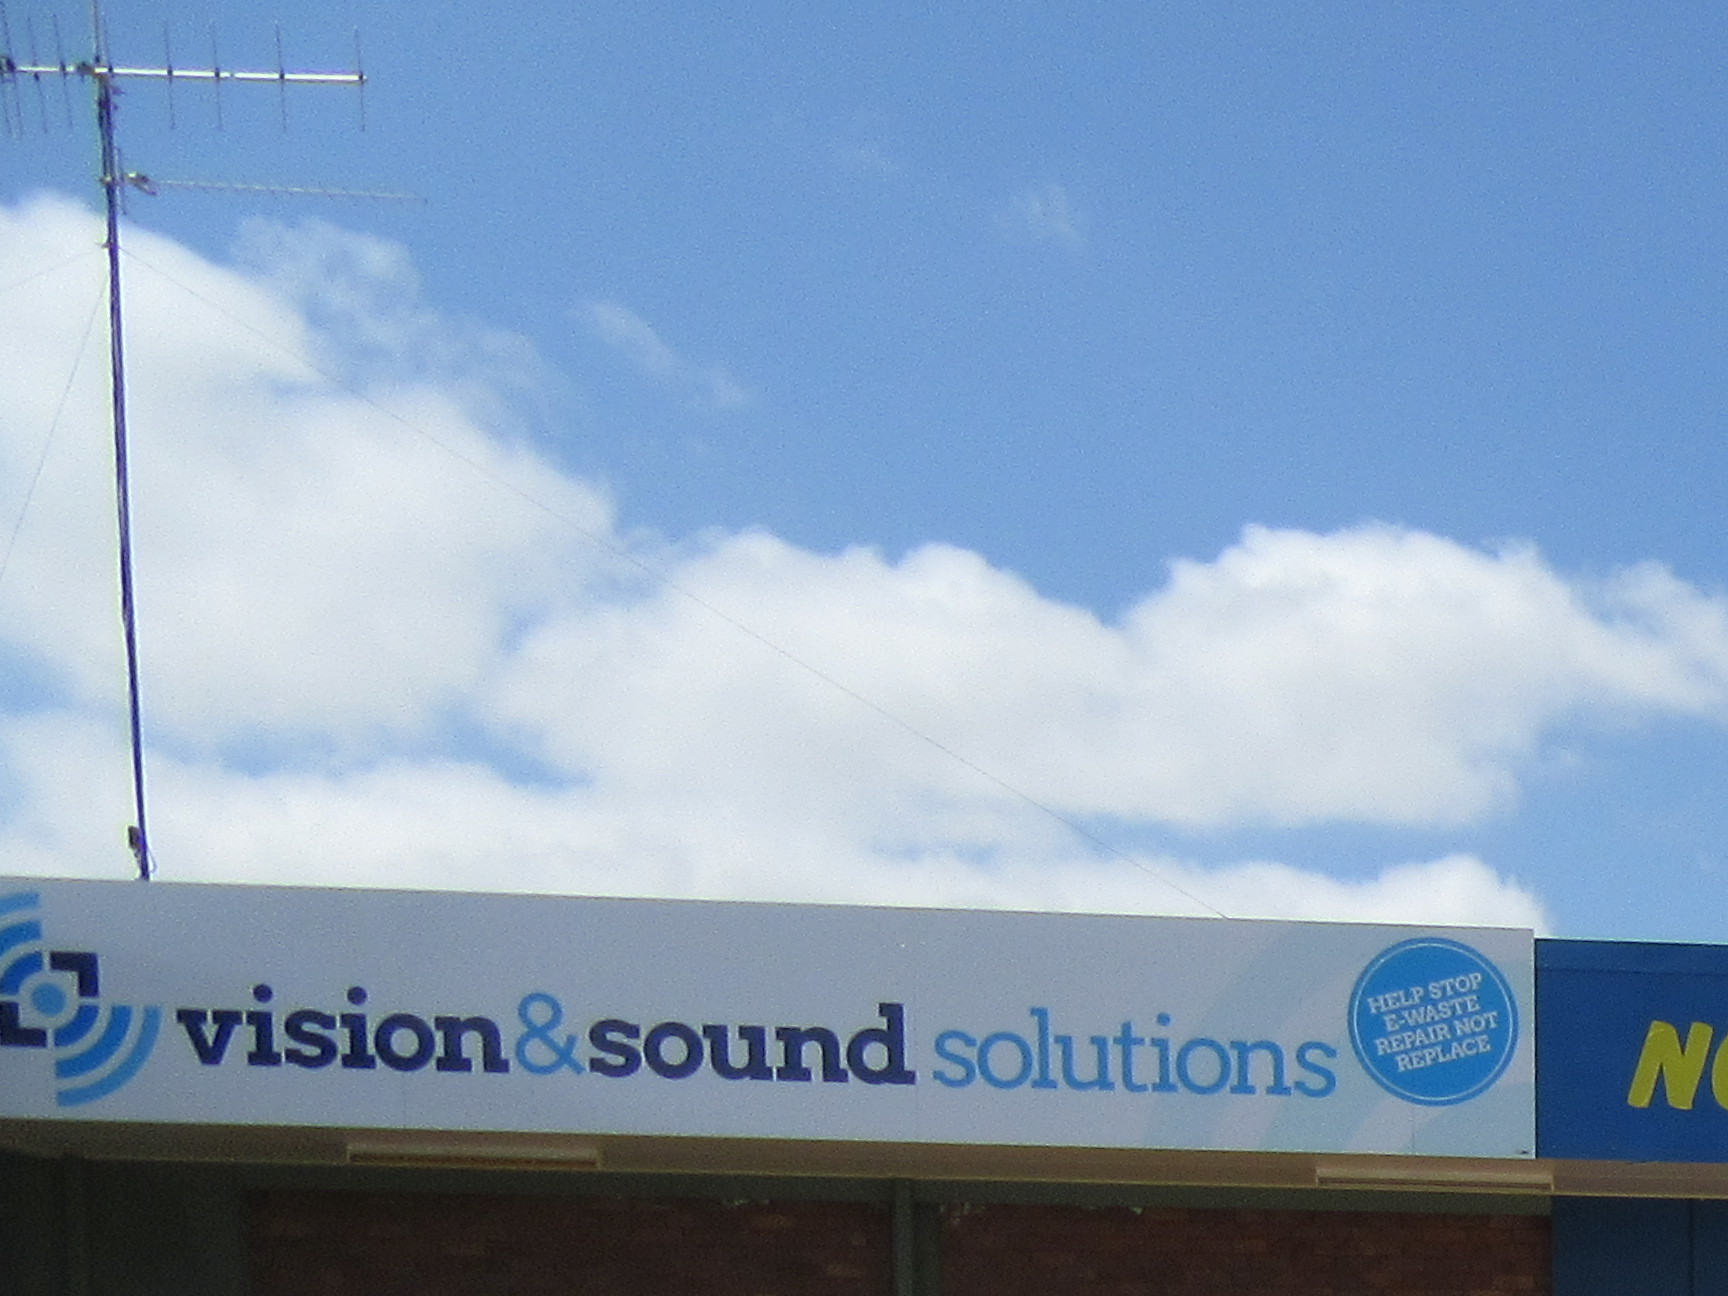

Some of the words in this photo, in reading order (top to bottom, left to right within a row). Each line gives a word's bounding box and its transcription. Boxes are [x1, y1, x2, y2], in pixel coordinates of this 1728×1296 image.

[1368, 987, 1424, 1014] HELP
[1428, 972, 1482, 1000] STOP
[1384, 995, 1480, 1032] E-WASTE
[933, 1008, 1338, 1098] solutions
[1374, 1024, 1452, 1055] REPAIR
[1454, 1012, 1498, 1037] NOT
[1395, 1035, 1491, 1072] REPLACE
